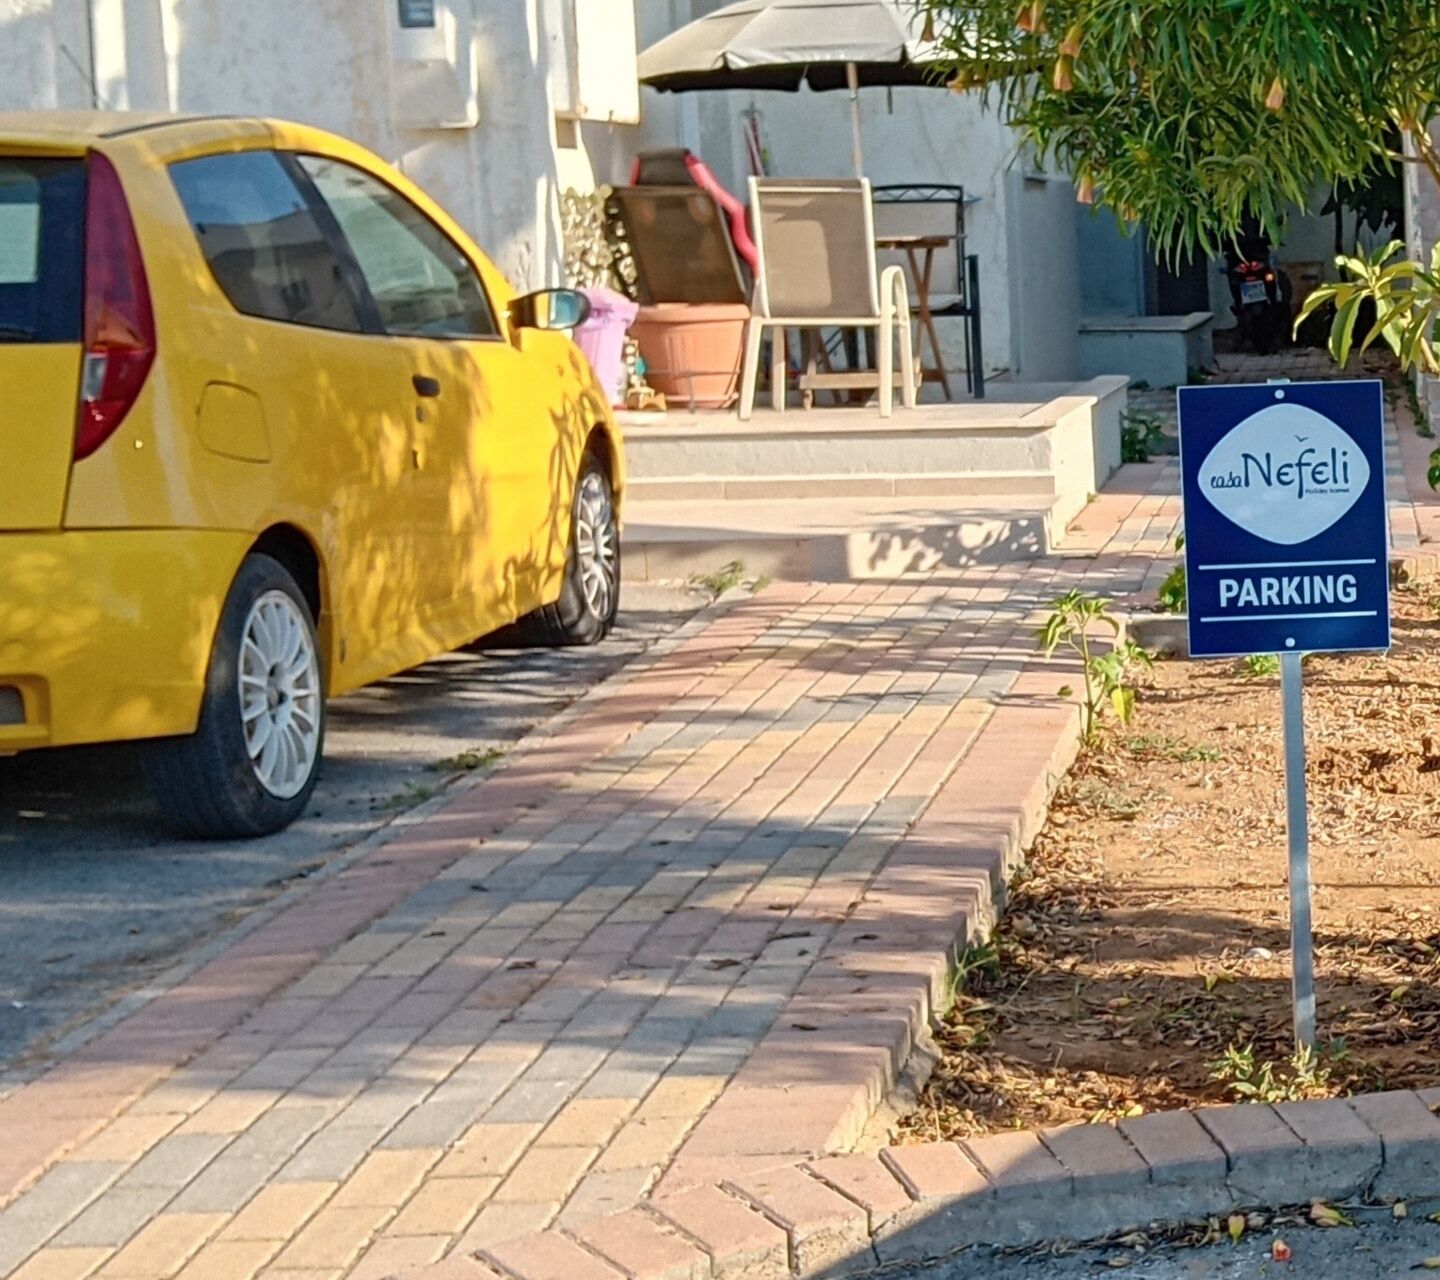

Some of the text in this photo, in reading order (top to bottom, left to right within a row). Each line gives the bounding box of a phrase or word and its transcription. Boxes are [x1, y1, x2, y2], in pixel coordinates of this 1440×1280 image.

[1210, 447, 1350, 500] casa Nefeli
[1218, 573, 1358, 608] PARKING
